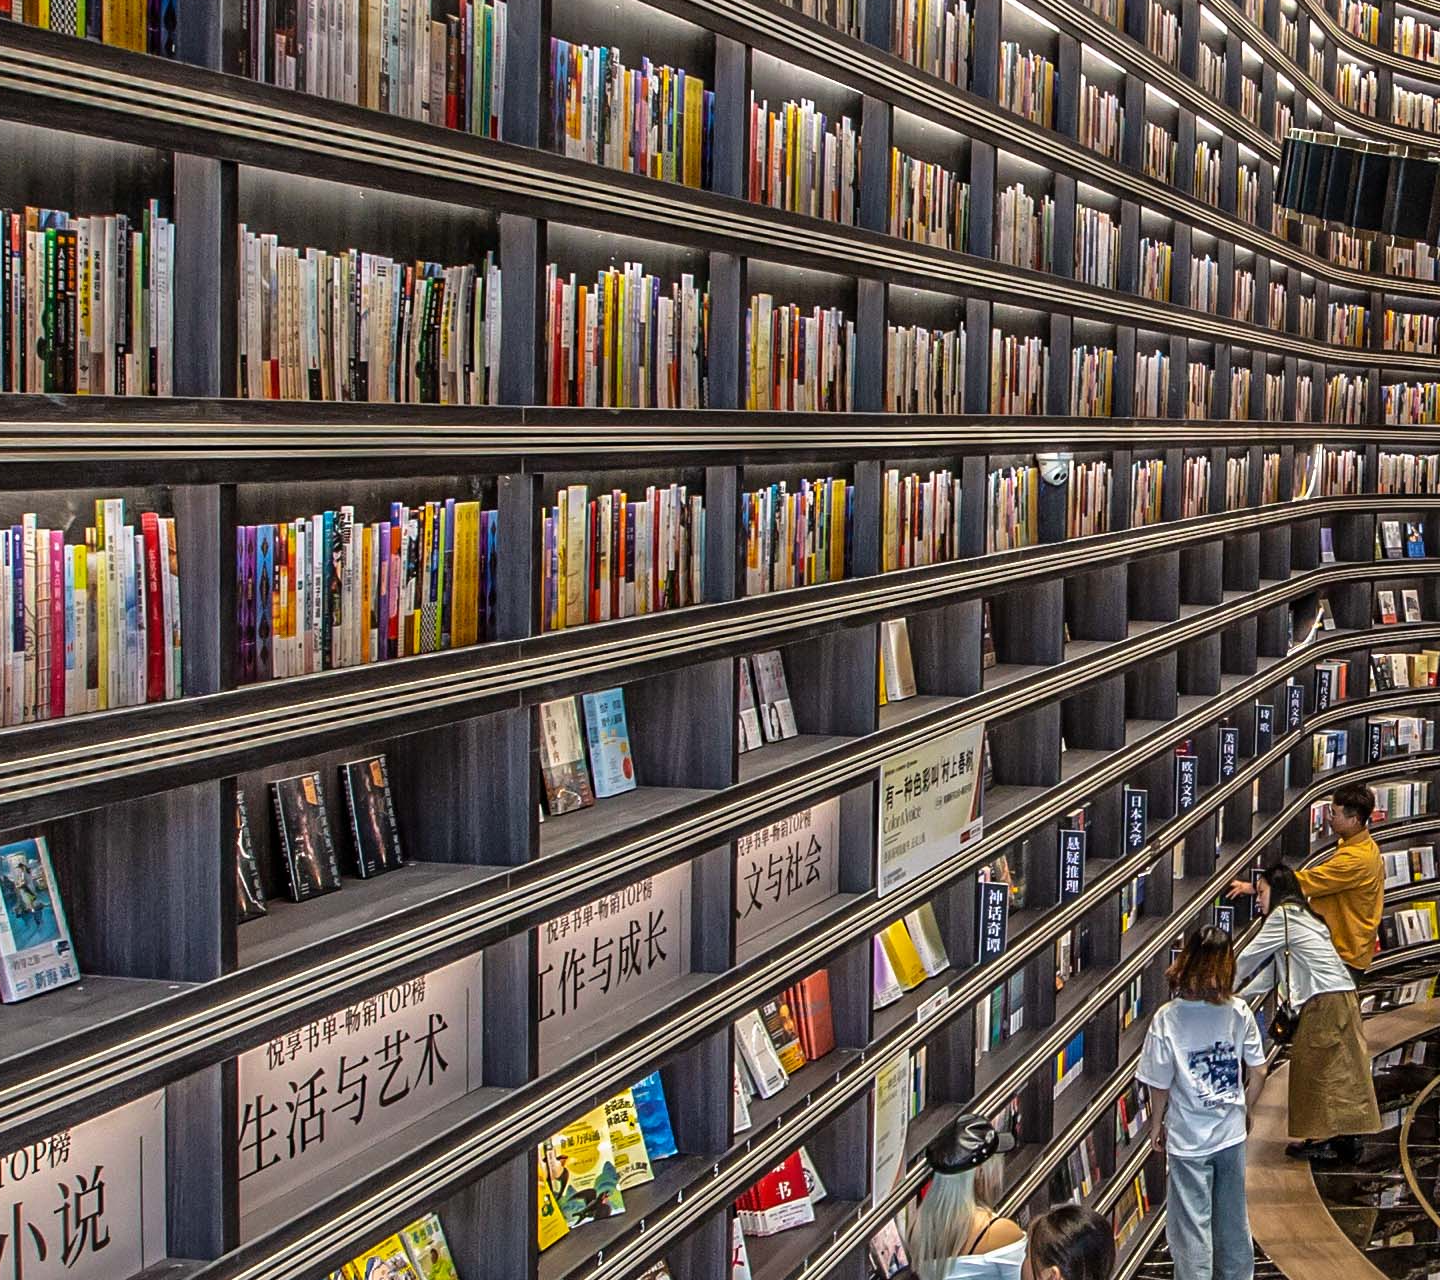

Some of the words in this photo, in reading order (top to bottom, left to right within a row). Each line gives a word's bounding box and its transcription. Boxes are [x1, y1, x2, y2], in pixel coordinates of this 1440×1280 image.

[1289, 689, 1301, 726] 古典文学
[1222, 732, 1236, 776] 美国文学
[1180, 760, 1195, 808] 欧美文学
[1128, 794, 1143, 845] 日本文学
[736, 834, 823, 920] 文与社会
[1065, 836, 1081, 895] 悬疑推理
[986, 888, 1004, 953] 神话奇谭
[537, 909, 668, 1023] 工作与成长
[238, 1012, 449, 1182] 生活与艺术
